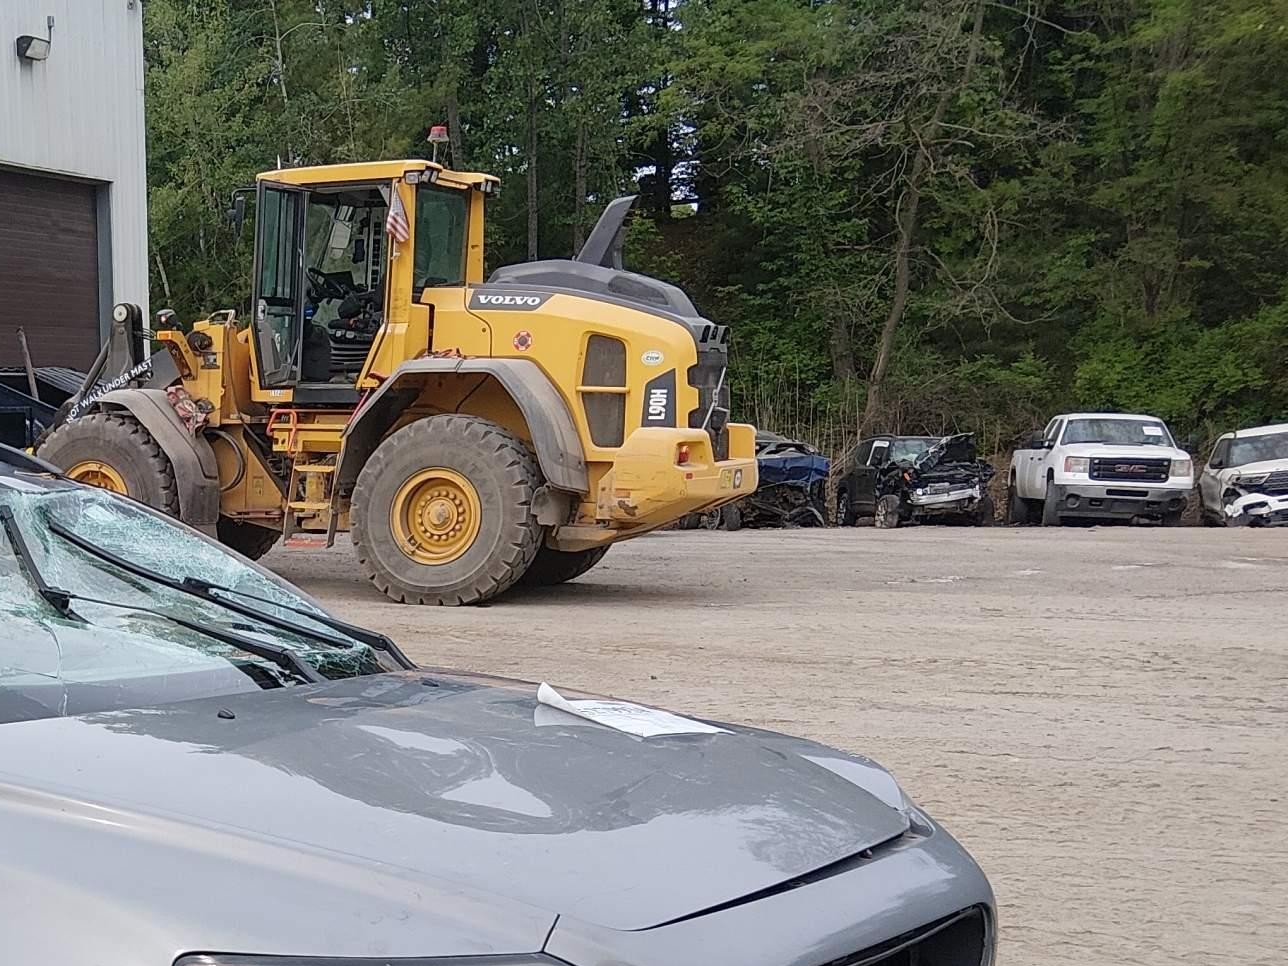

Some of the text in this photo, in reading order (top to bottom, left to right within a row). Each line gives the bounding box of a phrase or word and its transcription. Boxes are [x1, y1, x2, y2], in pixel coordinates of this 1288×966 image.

[477, 294, 541, 306] VOLVO
[66, 359, 153, 424] NOT WALK UNDER MAST
[648, 388, 668, 420] L90H
